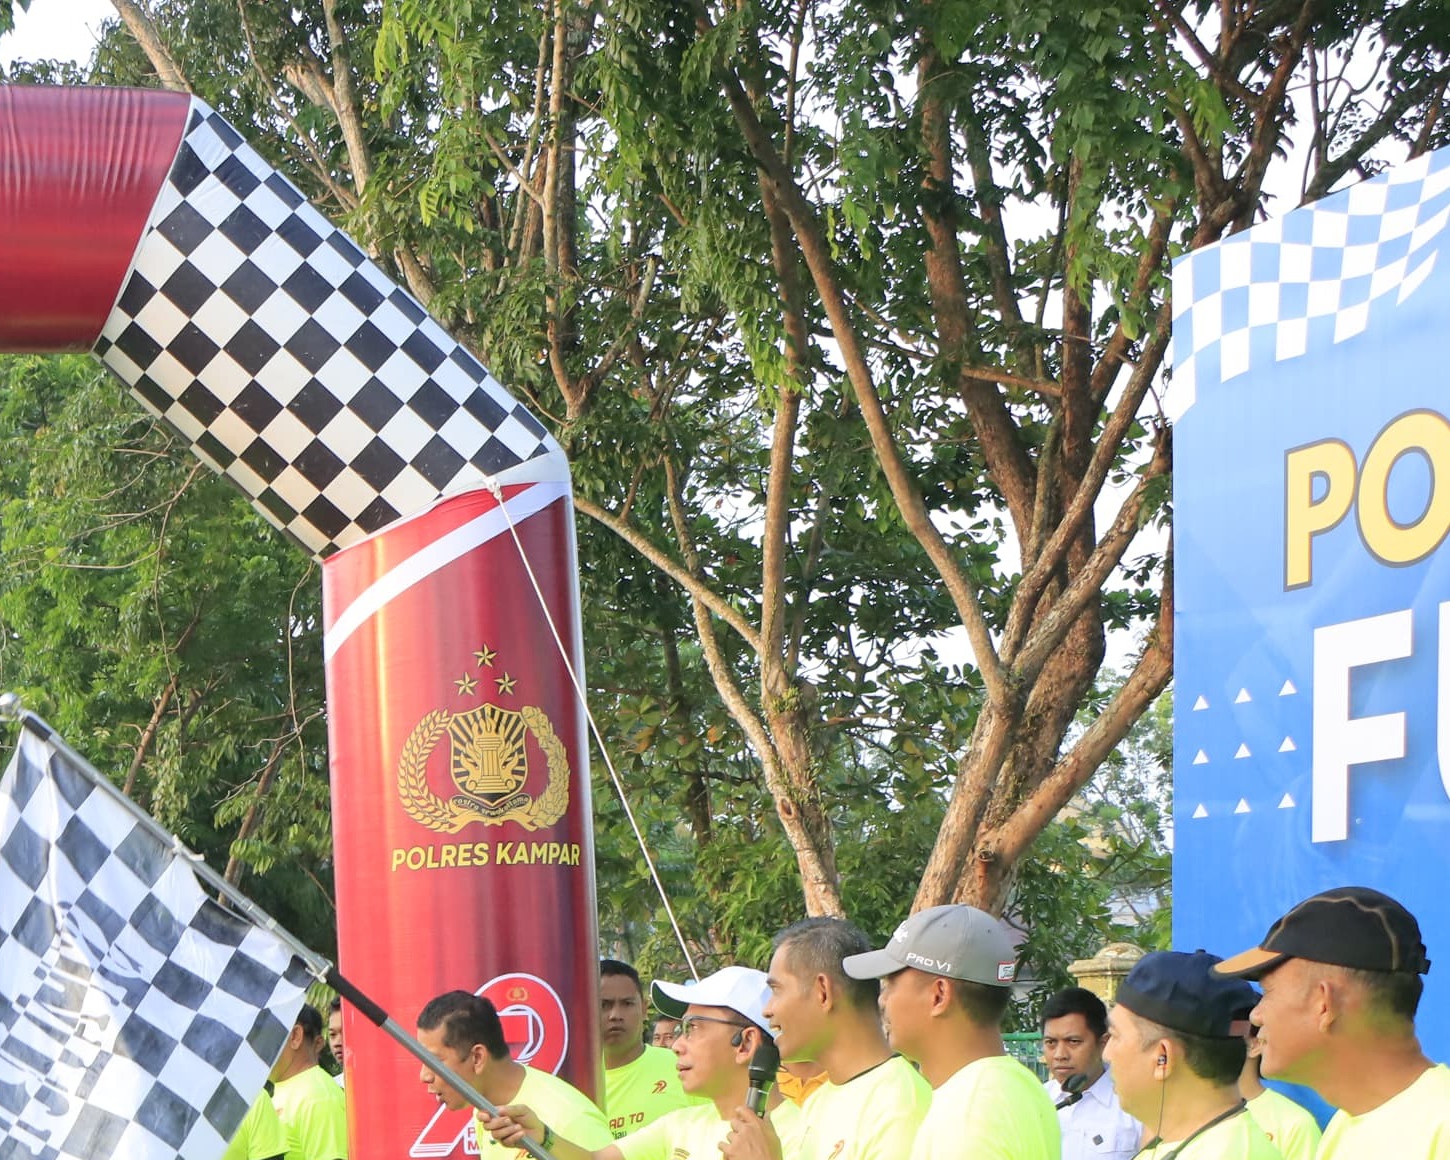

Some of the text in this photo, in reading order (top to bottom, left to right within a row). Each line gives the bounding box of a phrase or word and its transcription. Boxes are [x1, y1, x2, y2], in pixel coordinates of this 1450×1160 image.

[1311, 600, 1450, 844] F
[391, 841, 580, 872] POLRES KAMPAR
[906, 952, 934, 966] PRO
[629, 1112, 645, 1124] TO
